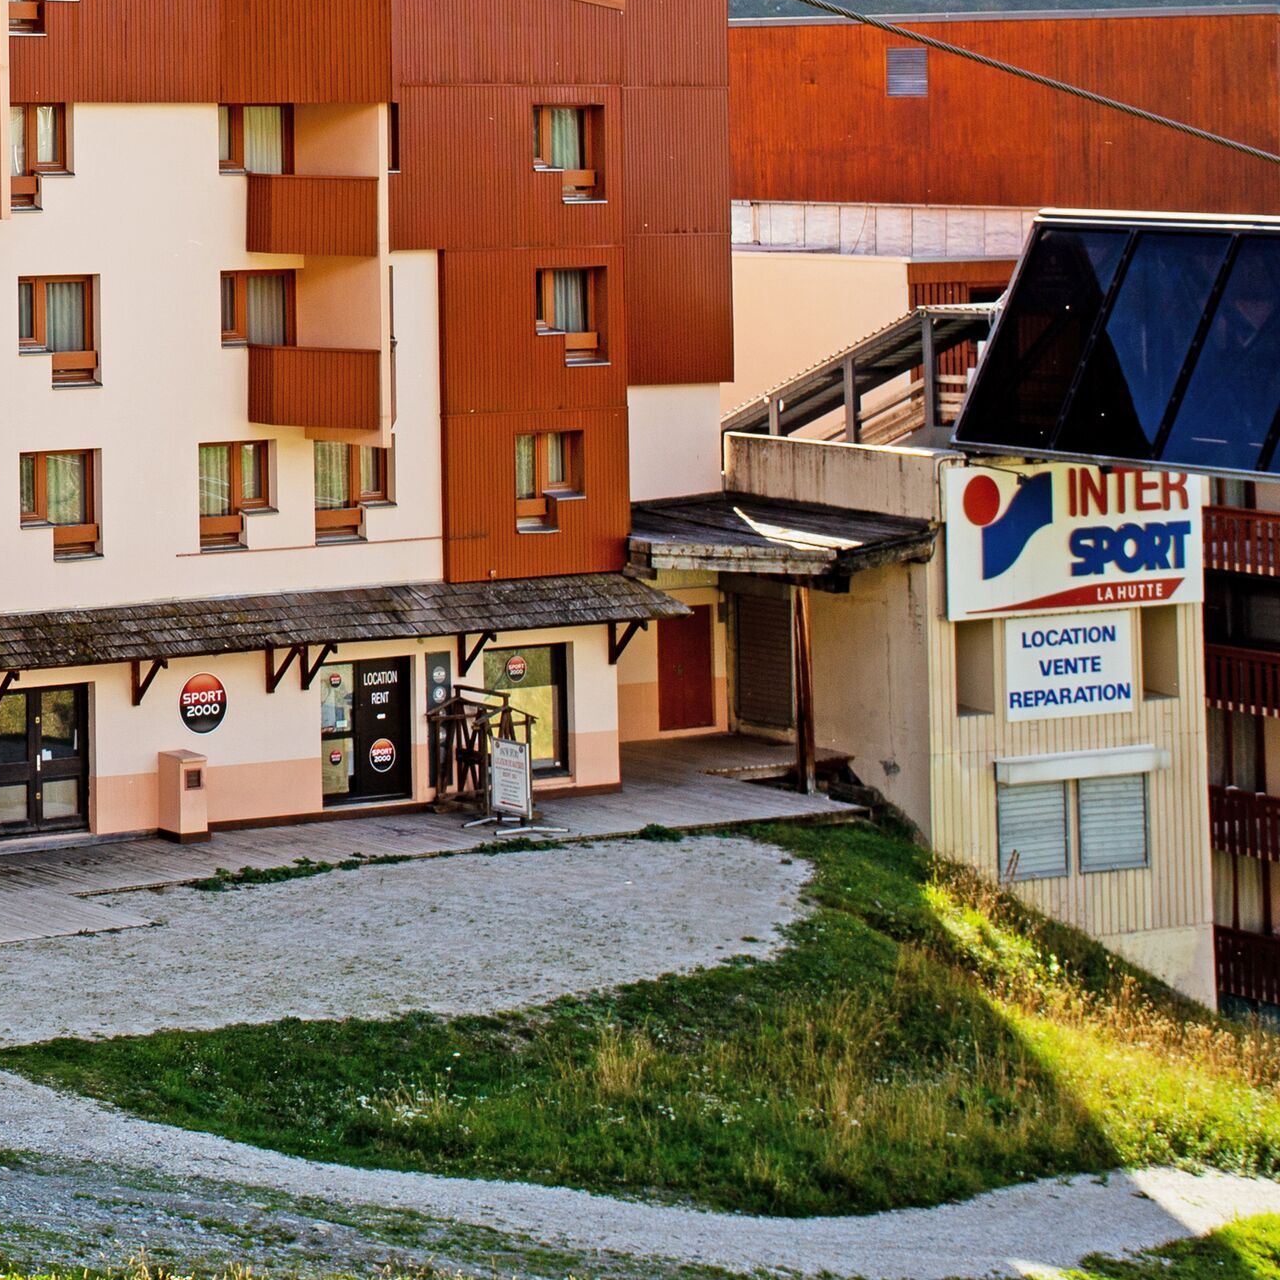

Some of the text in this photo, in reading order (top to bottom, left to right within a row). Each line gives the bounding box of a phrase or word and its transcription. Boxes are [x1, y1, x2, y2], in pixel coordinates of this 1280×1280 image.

[1068, 466, 1189, 517] INTER
[1069, 520, 1191, 577] SPORT
[1097, 583, 1163, 601] LA HUTTE
[1021, 625, 1116, 649] LOCATION
[1039, 655, 1102, 677] VENTE
[363, 670, 398, 686] LOCATION
[182, 689, 223, 705] SPORT
[371, 691, 390, 705] RENT
[1009, 682, 1131, 709] REPARATION
[187, 703, 220, 717] 2000
[371, 747, 392, 756] SPORT
[373, 754, 391, 763] 2000
